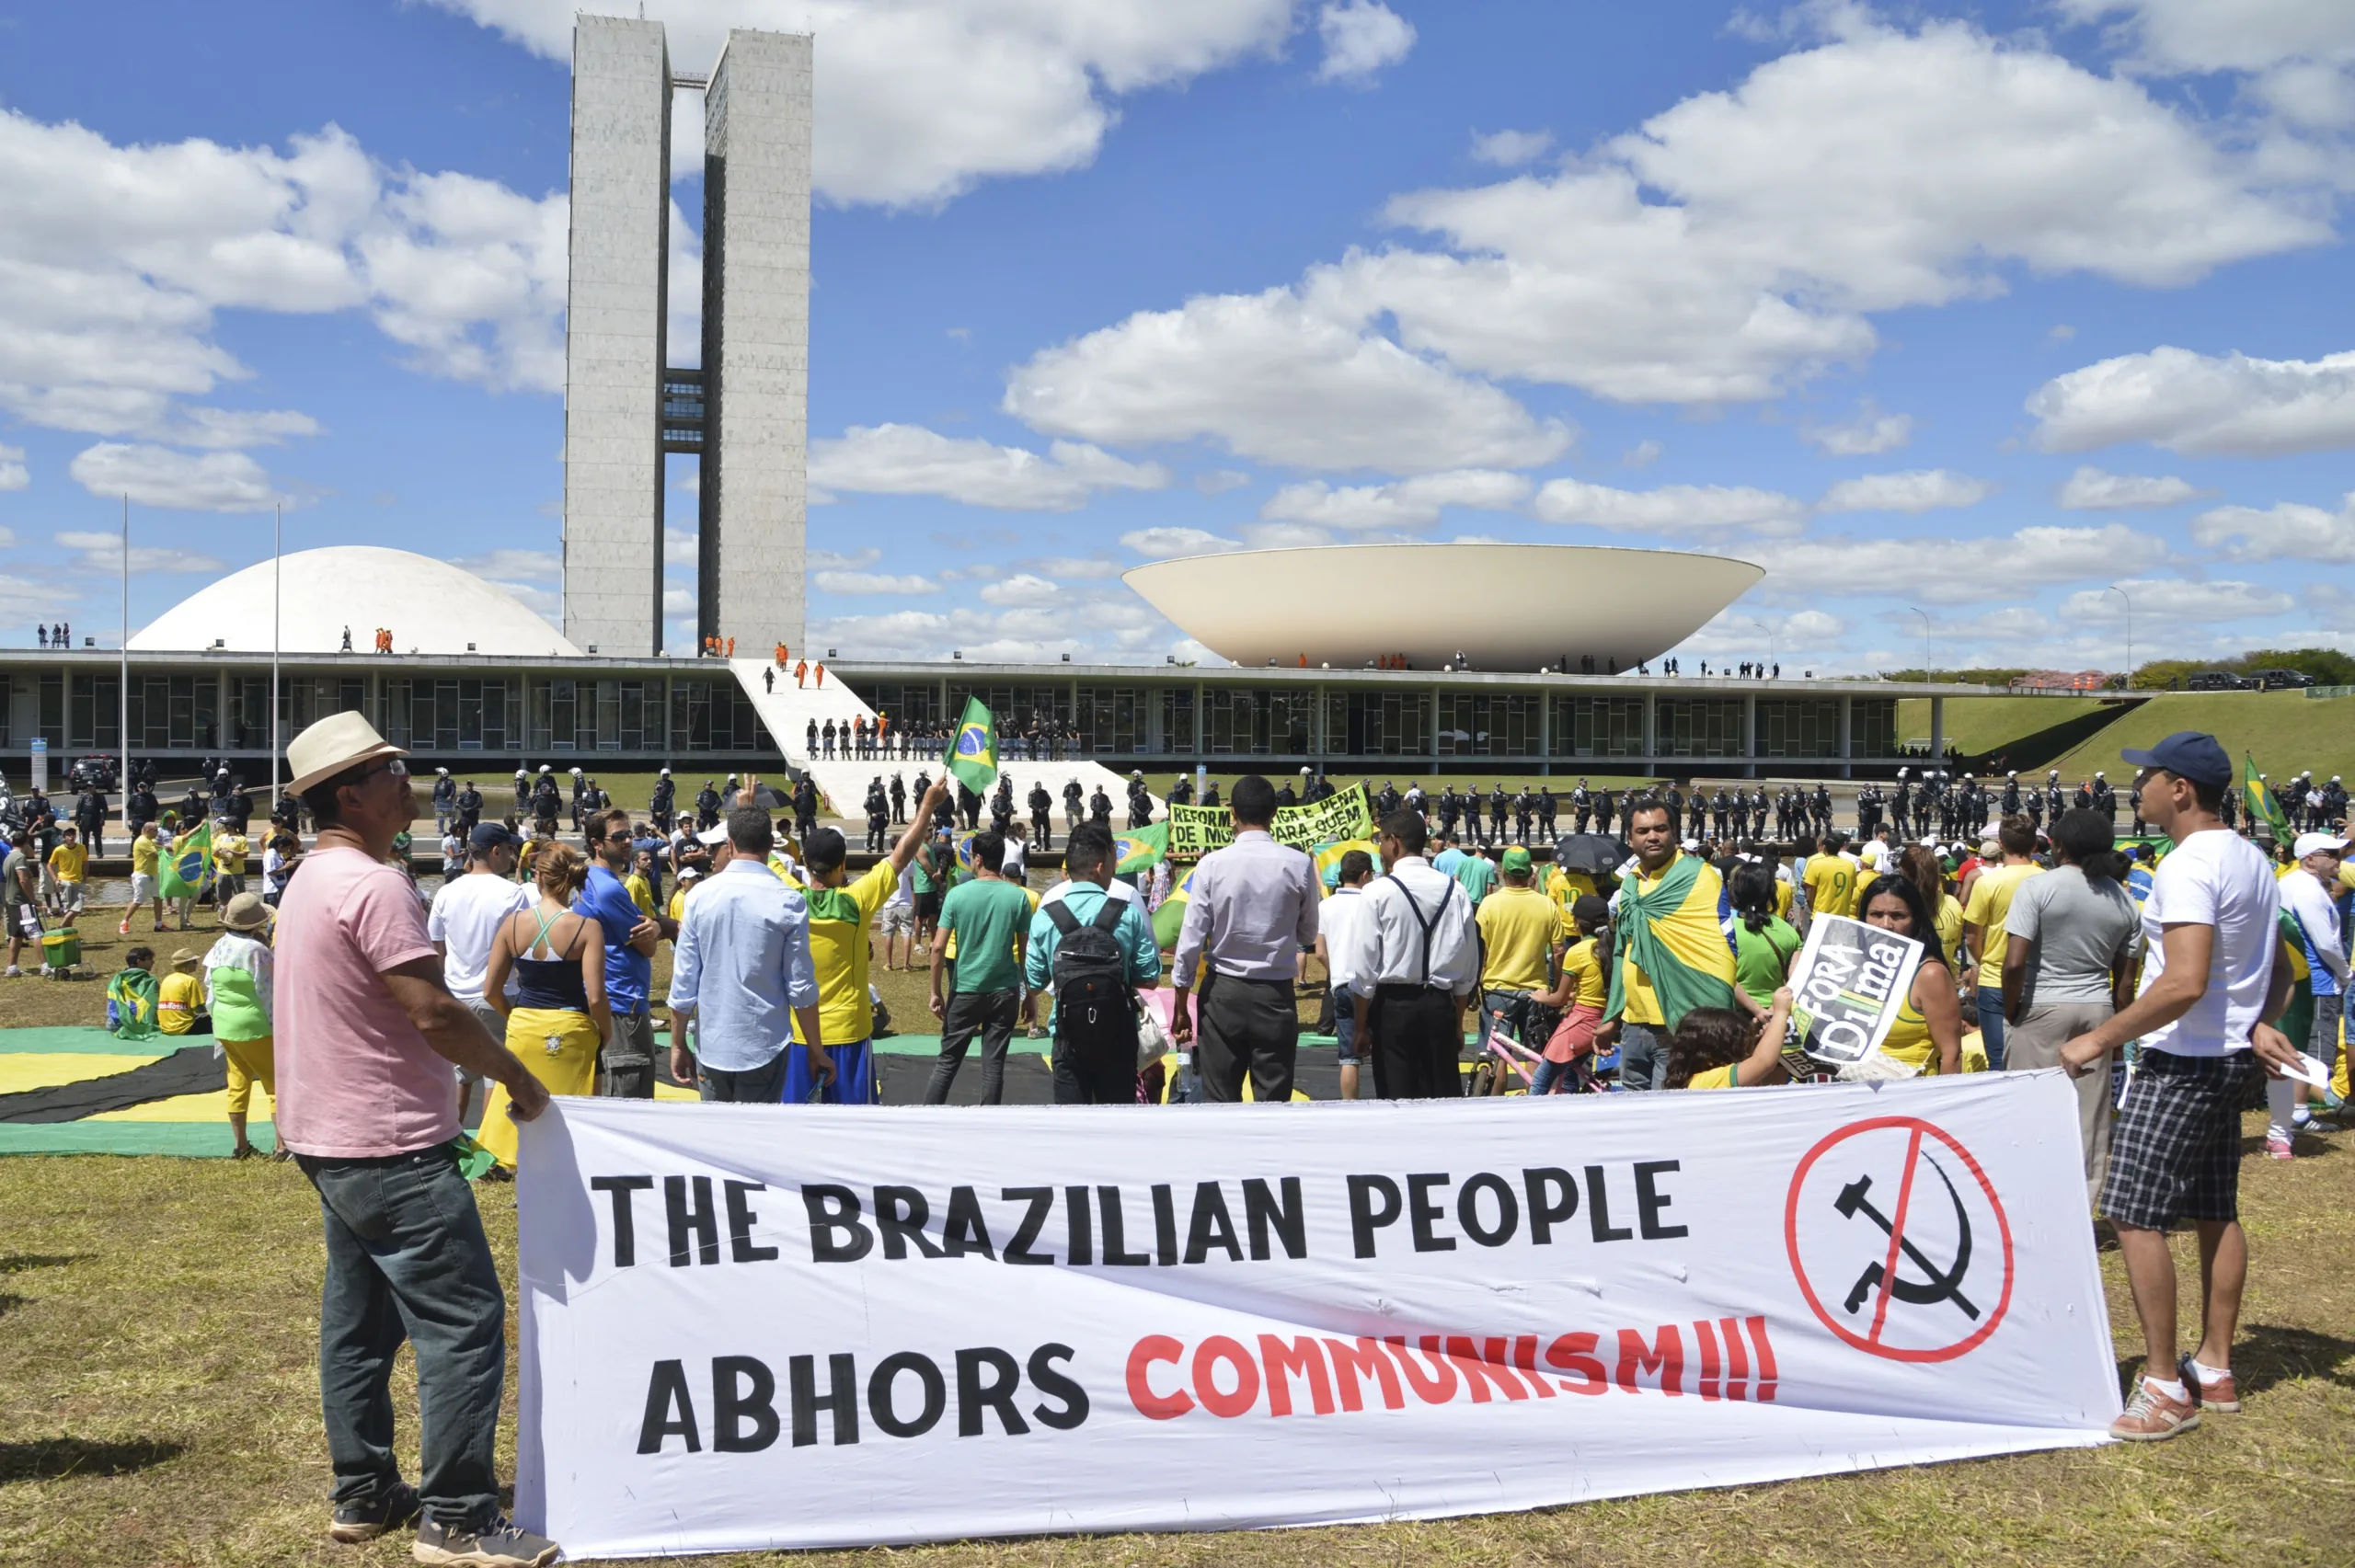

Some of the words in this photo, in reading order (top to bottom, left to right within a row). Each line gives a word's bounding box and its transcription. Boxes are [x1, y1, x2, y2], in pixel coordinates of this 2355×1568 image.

[1174, 807, 1230, 827] REFORM
[1303, 807, 1314, 818] E
[1319, 787, 1360, 814] PENA
[1176, 826, 1196, 843] DE
[1315, 806, 1361, 832] QUEM
[1833, 871, 1847, 898] 9
[1798, 944, 1864, 1022] FORA
[592, 1175, 778, 1267] THE
[800, 1177, 1307, 1266] BRAZILIAN
[1347, 1160, 1688, 1259] PEOPLE
[637, 1343, 1090, 1454] ABHORS
[1126, 1316, 1778, 1421] COMMUNISM!!!
